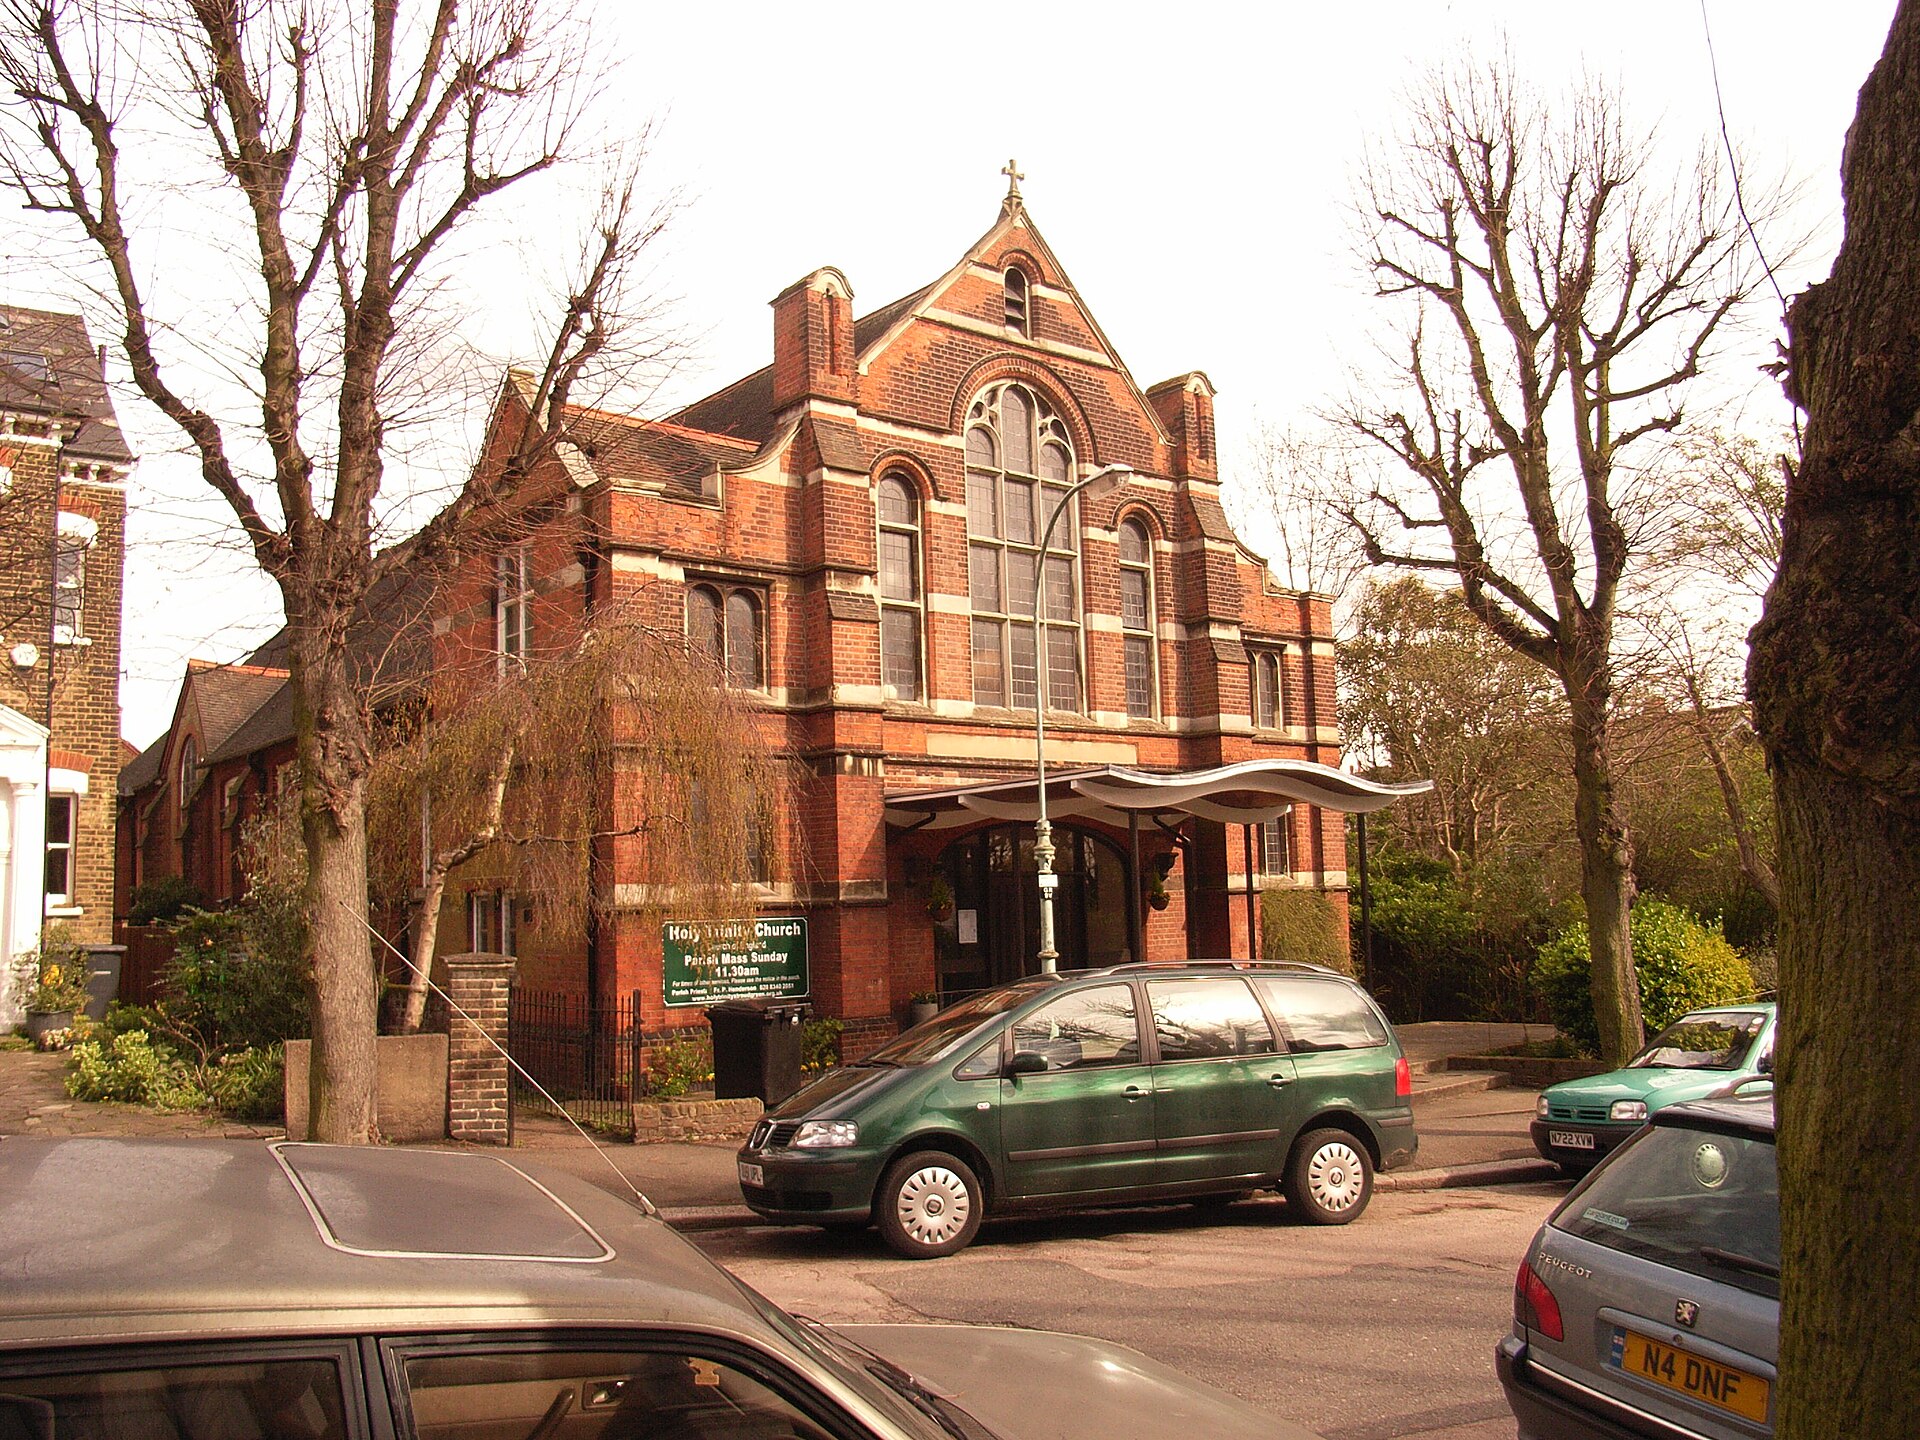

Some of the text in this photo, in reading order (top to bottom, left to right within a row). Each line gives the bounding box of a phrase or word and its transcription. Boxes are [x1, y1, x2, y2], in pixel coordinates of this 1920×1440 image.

[669, 925, 701, 943] Holy
[755, 922, 801, 937] Church
[684, 951, 788, 966] Parish Mass Sunday
[715, 965, 760, 977] 11.30am
[1538, 1251, 1593, 1279] PEUGEOT
[1643, 1343, 1741, 1403] N4 DNF
